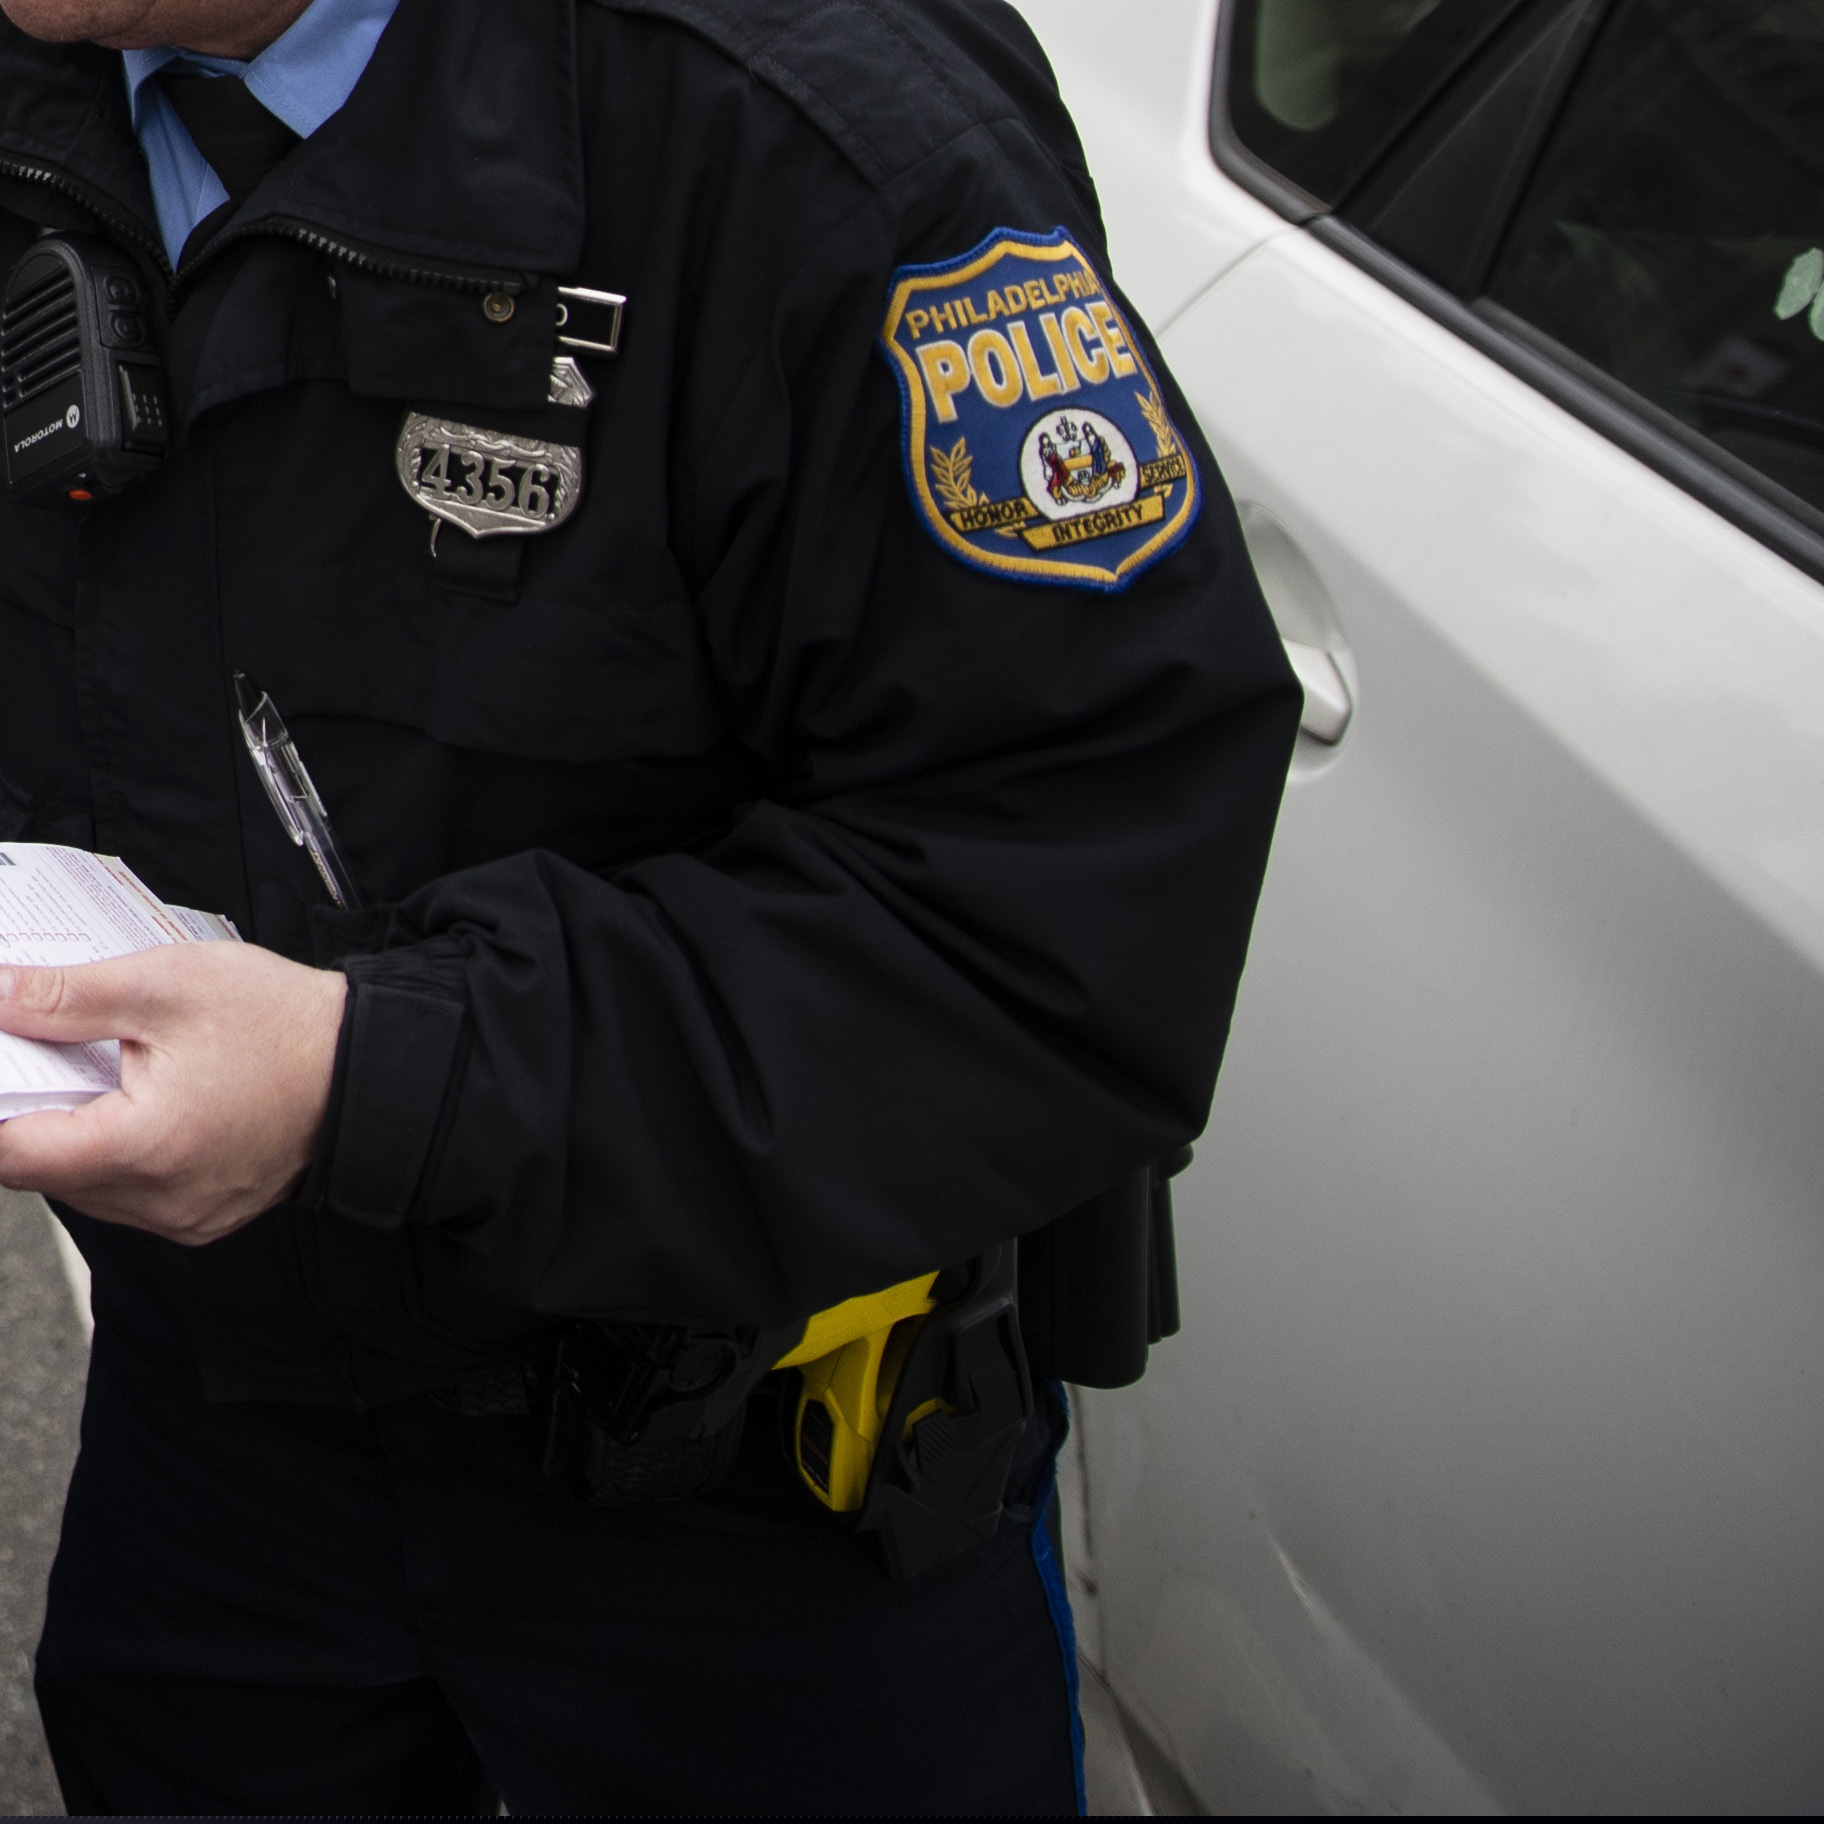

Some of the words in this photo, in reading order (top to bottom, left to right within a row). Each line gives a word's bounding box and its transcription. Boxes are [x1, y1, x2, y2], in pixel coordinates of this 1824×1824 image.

[905, 268, 1098, 340] PHILADELPHIA
[916, 301, 1139, 424] POLICE
[13, 417, 63, 453] MOTOROLA
[421, 442, 552, 521] 4356
[961, 500, 1029, 527] HONOR
[1052, 503, 1144, 543] INTEGRITY
